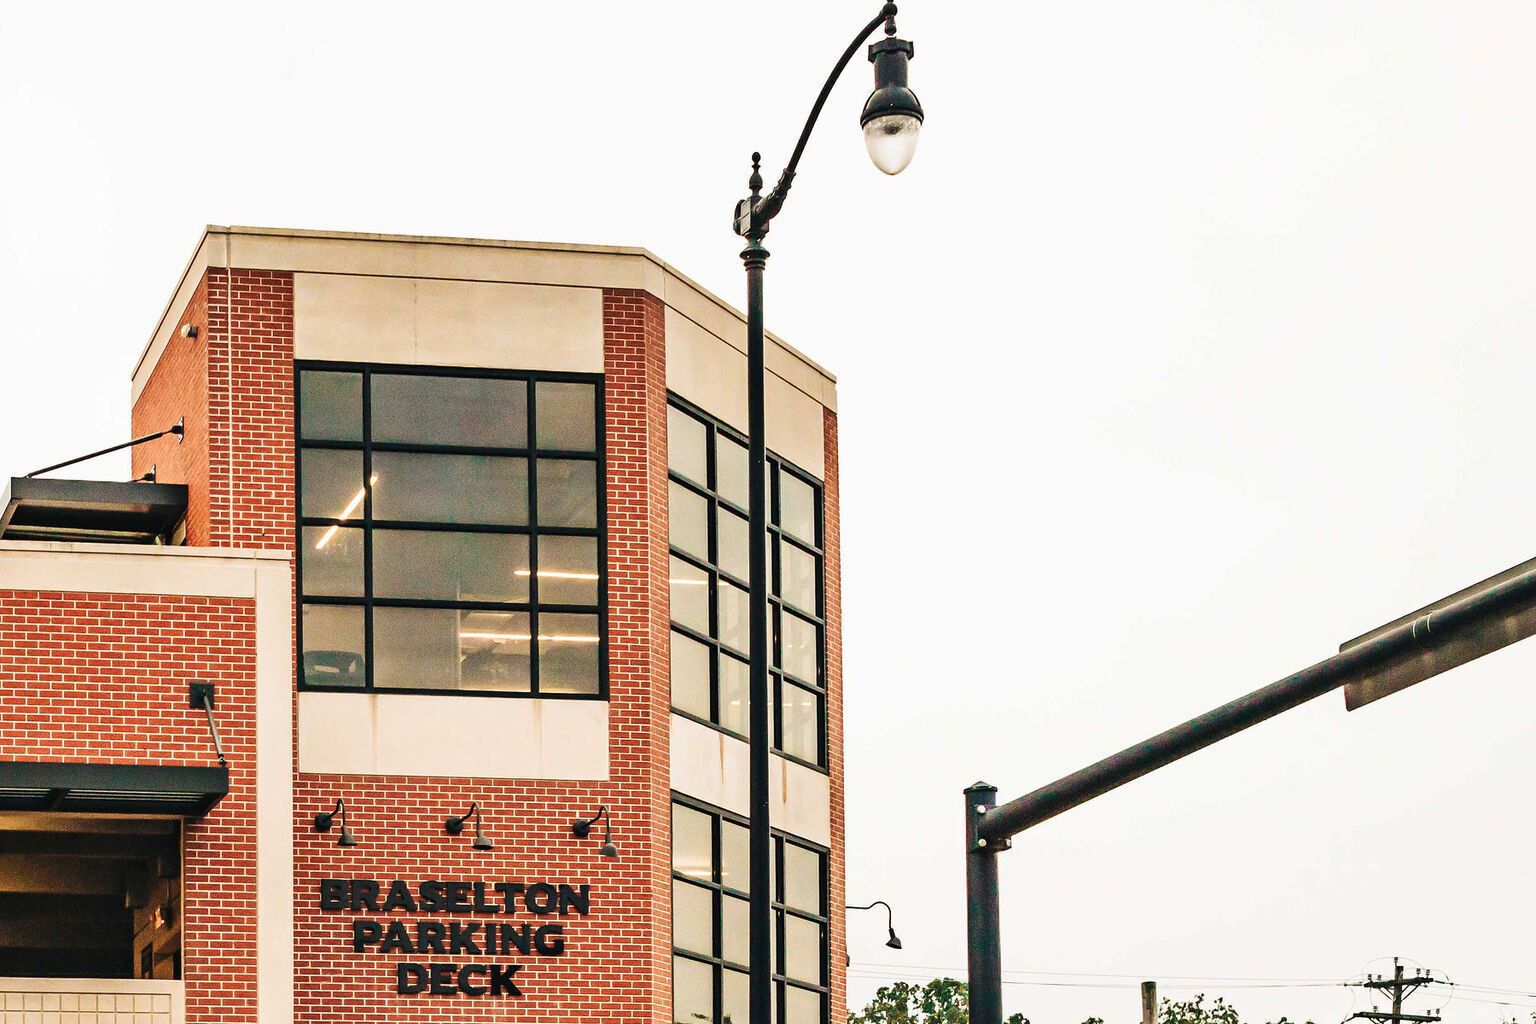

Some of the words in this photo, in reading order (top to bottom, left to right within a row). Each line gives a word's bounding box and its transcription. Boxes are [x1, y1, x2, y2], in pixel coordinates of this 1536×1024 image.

[320, 879, 590, 915] BRASELTON
[353, 920, 565, 956] PARKING
[397, 962, 523, 997] DECK
